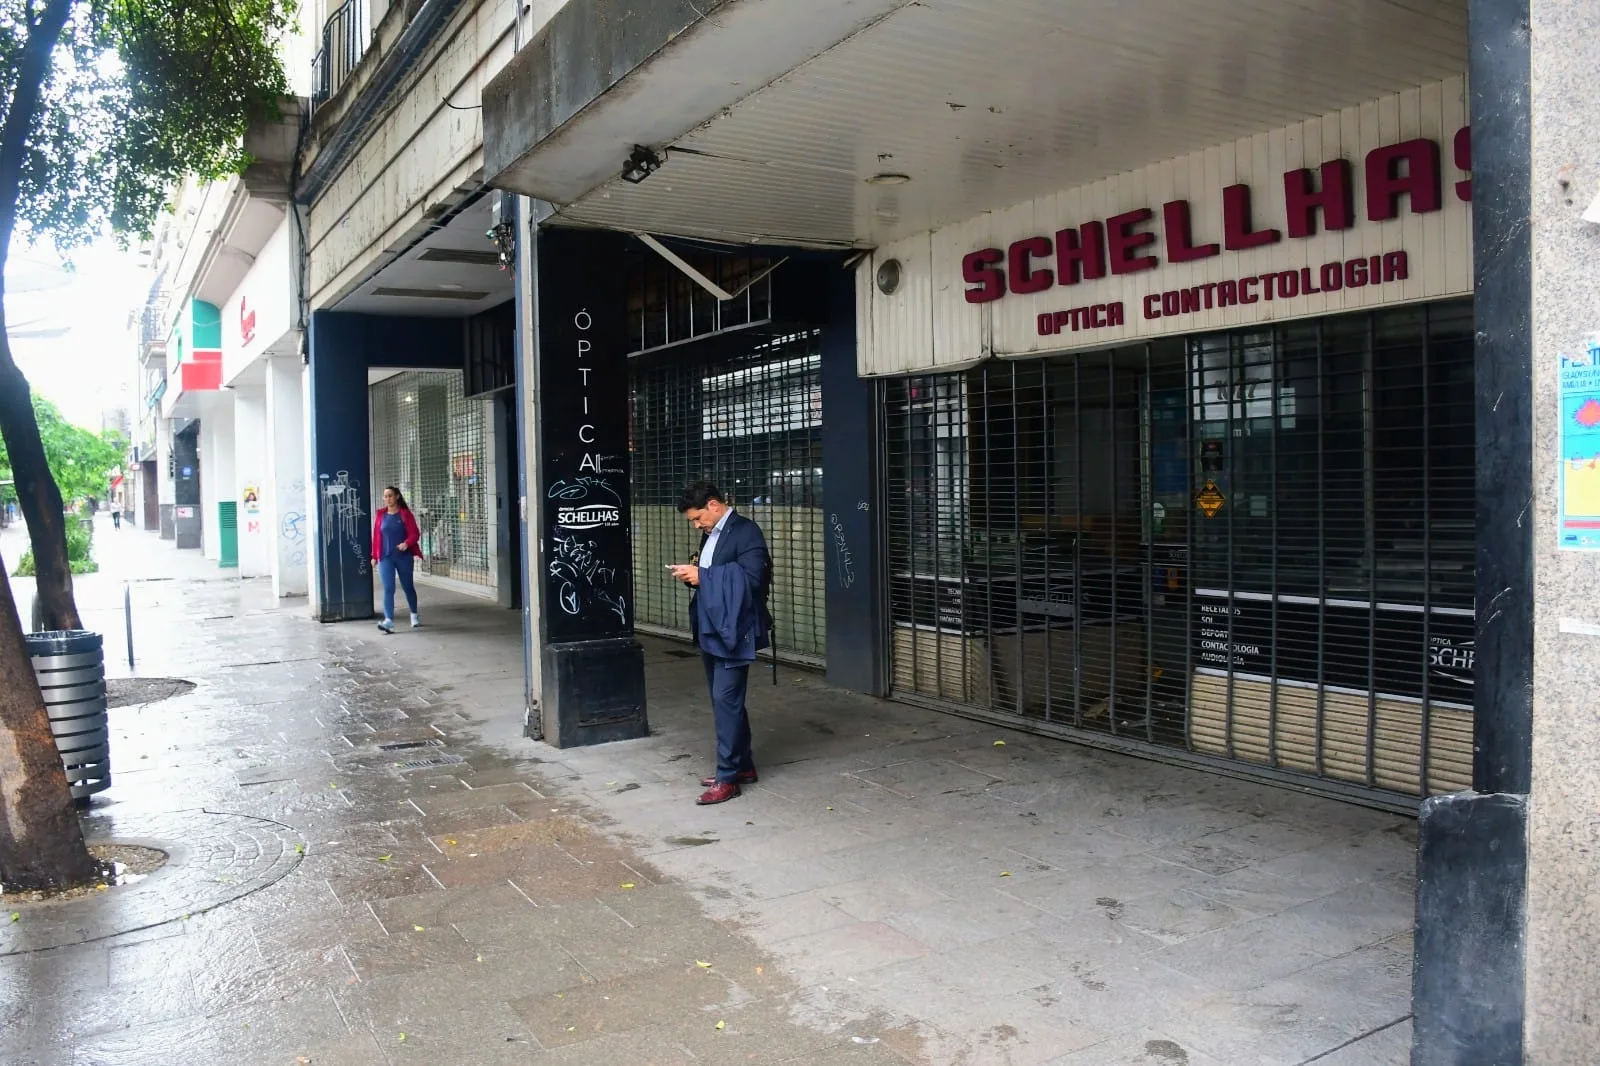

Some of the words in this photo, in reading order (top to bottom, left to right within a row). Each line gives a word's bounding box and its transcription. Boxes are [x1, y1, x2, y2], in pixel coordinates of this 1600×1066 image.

[961, 126, 1471, 303] SCHELLHA
[1037, 301, 1124, 336] OPTICA
[1143, 250, 1408, 319] CONTACTOLOGIA
[574, 307, 596, 471] ÓPTICA
[557, 510, 619, 524] SCHELLHAS
[1430, 637, 1451, 646] PTICA
